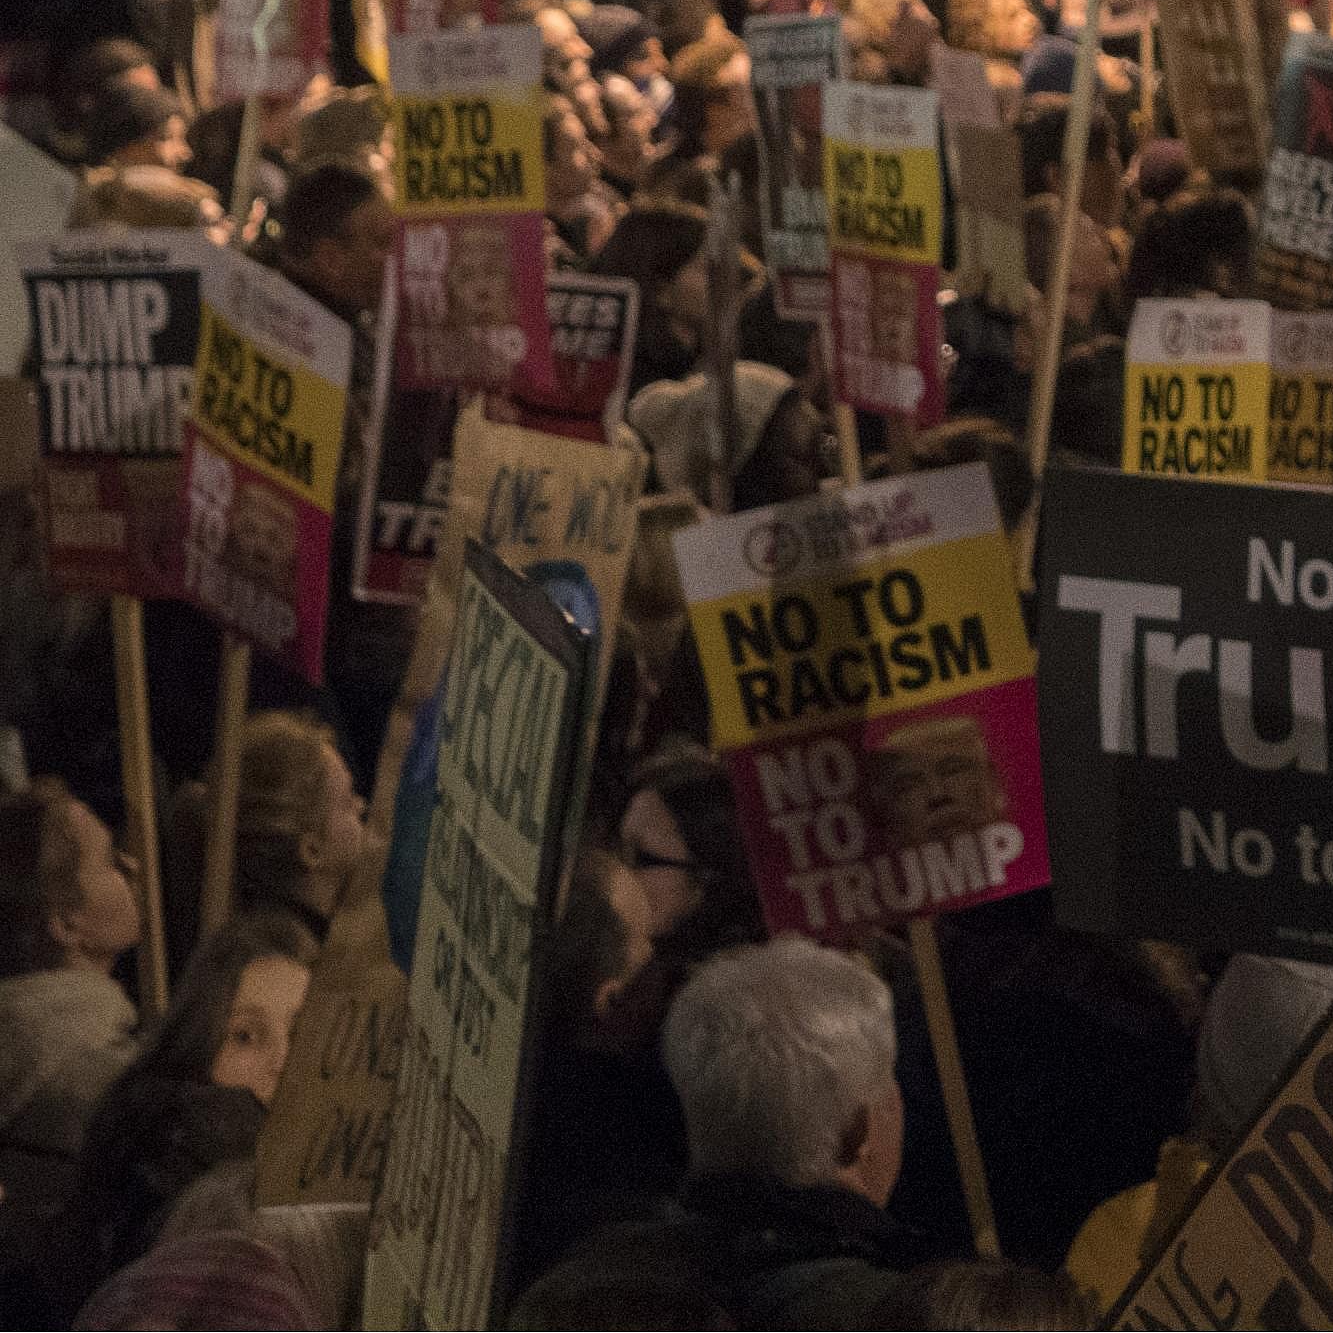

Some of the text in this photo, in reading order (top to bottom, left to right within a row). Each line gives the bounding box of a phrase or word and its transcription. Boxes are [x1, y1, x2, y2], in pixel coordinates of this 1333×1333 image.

[403, 100, 493, 148] NO TO
[403, 149, 526, 202] RACISM
[873, 154, 903, 199] TO
[35, 278, 171, 366] DUMP
[41, 365, 196, 452] TRUMP
[254, 356, 295, 417] TO
[1140, 374, 1237, 423] NO TO
[202, 373, 315, 489] RACISM
[1137, 427, 1254, 475] RACISM
[720, 568, 926, 668] NO TO
[735, 612, 993, 728] RACISM
[752, 737, 858, 813] NO
[768, 801, 867, 871] TO
[1175, 806, 1276, 879] No
[786, 820, 1025, 930] TRUMP
